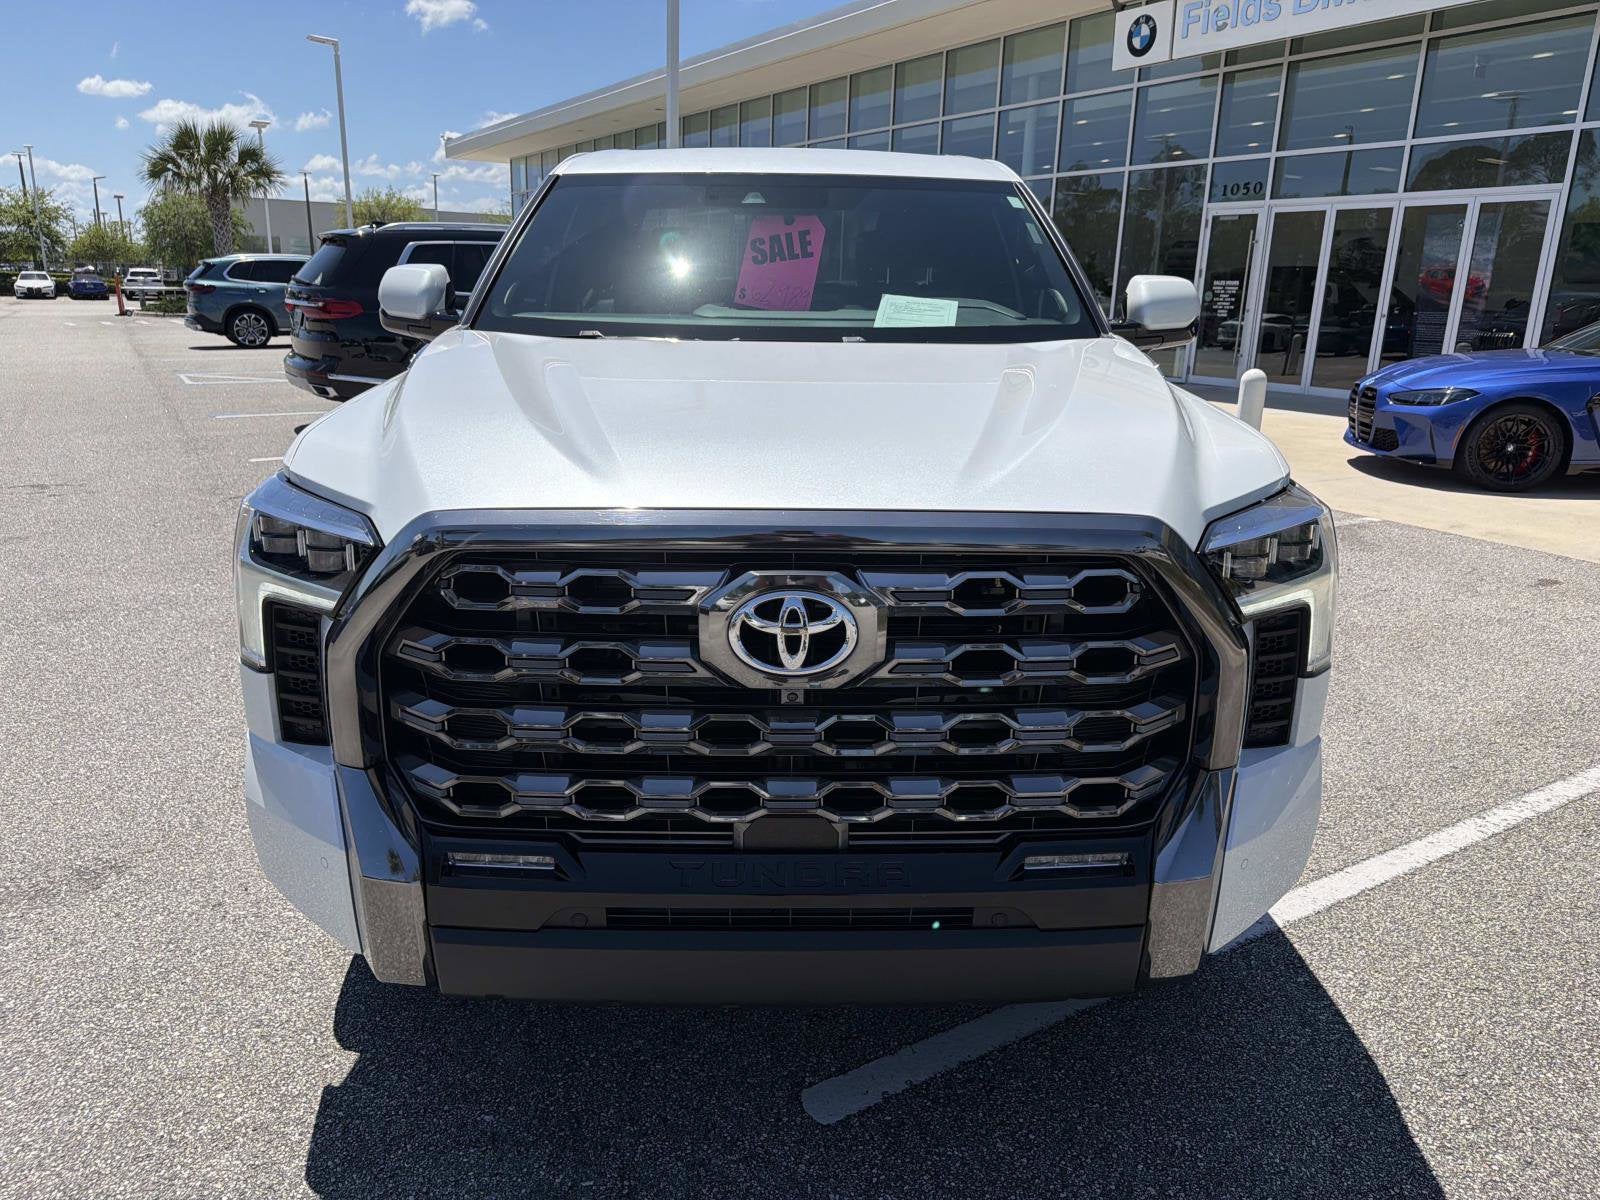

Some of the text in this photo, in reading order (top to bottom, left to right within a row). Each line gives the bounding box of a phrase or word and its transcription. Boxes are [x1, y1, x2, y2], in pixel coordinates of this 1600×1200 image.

[1181, 0, 1281, 39] Fields
[1222, 181, 1263, 197] 1050
[751, 229, 814, 266] SALE
[668, 860, 912, 888] TUNDRA
